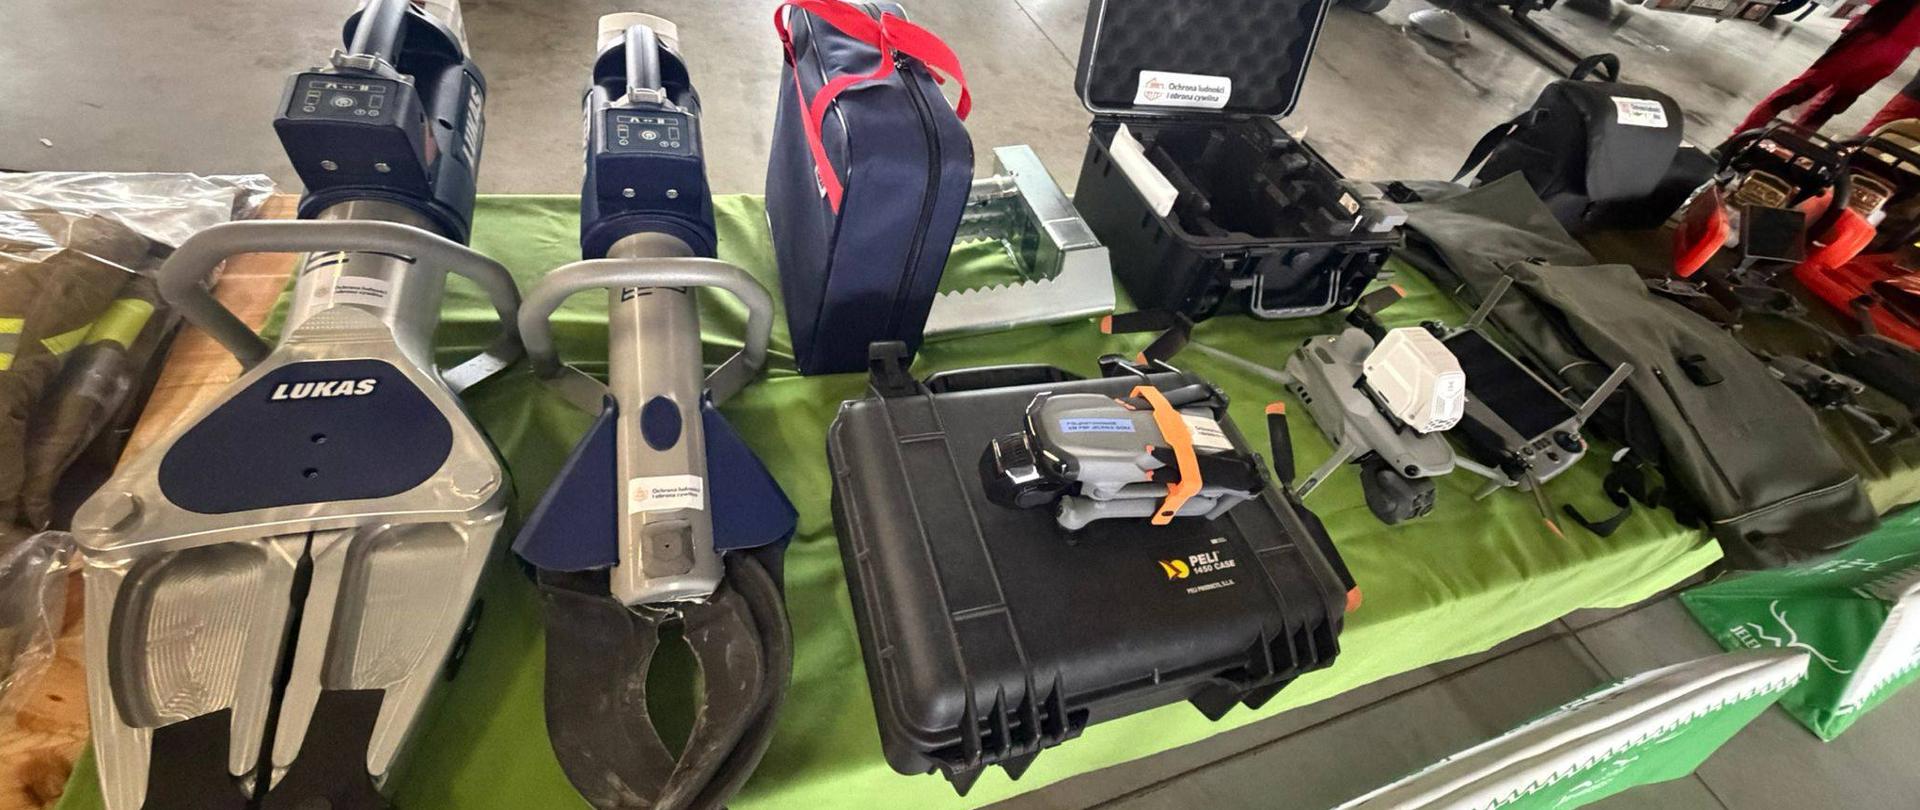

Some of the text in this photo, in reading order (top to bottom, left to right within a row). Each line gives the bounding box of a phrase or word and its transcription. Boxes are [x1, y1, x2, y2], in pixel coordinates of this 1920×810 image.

[1168, 82, 1197, 92] Ochrona
[270, 378, 377, 400] LUKAS
[1188, 551, 1219, 567] PELI
[1193, 559, 1236, 574] 1450 CASE
